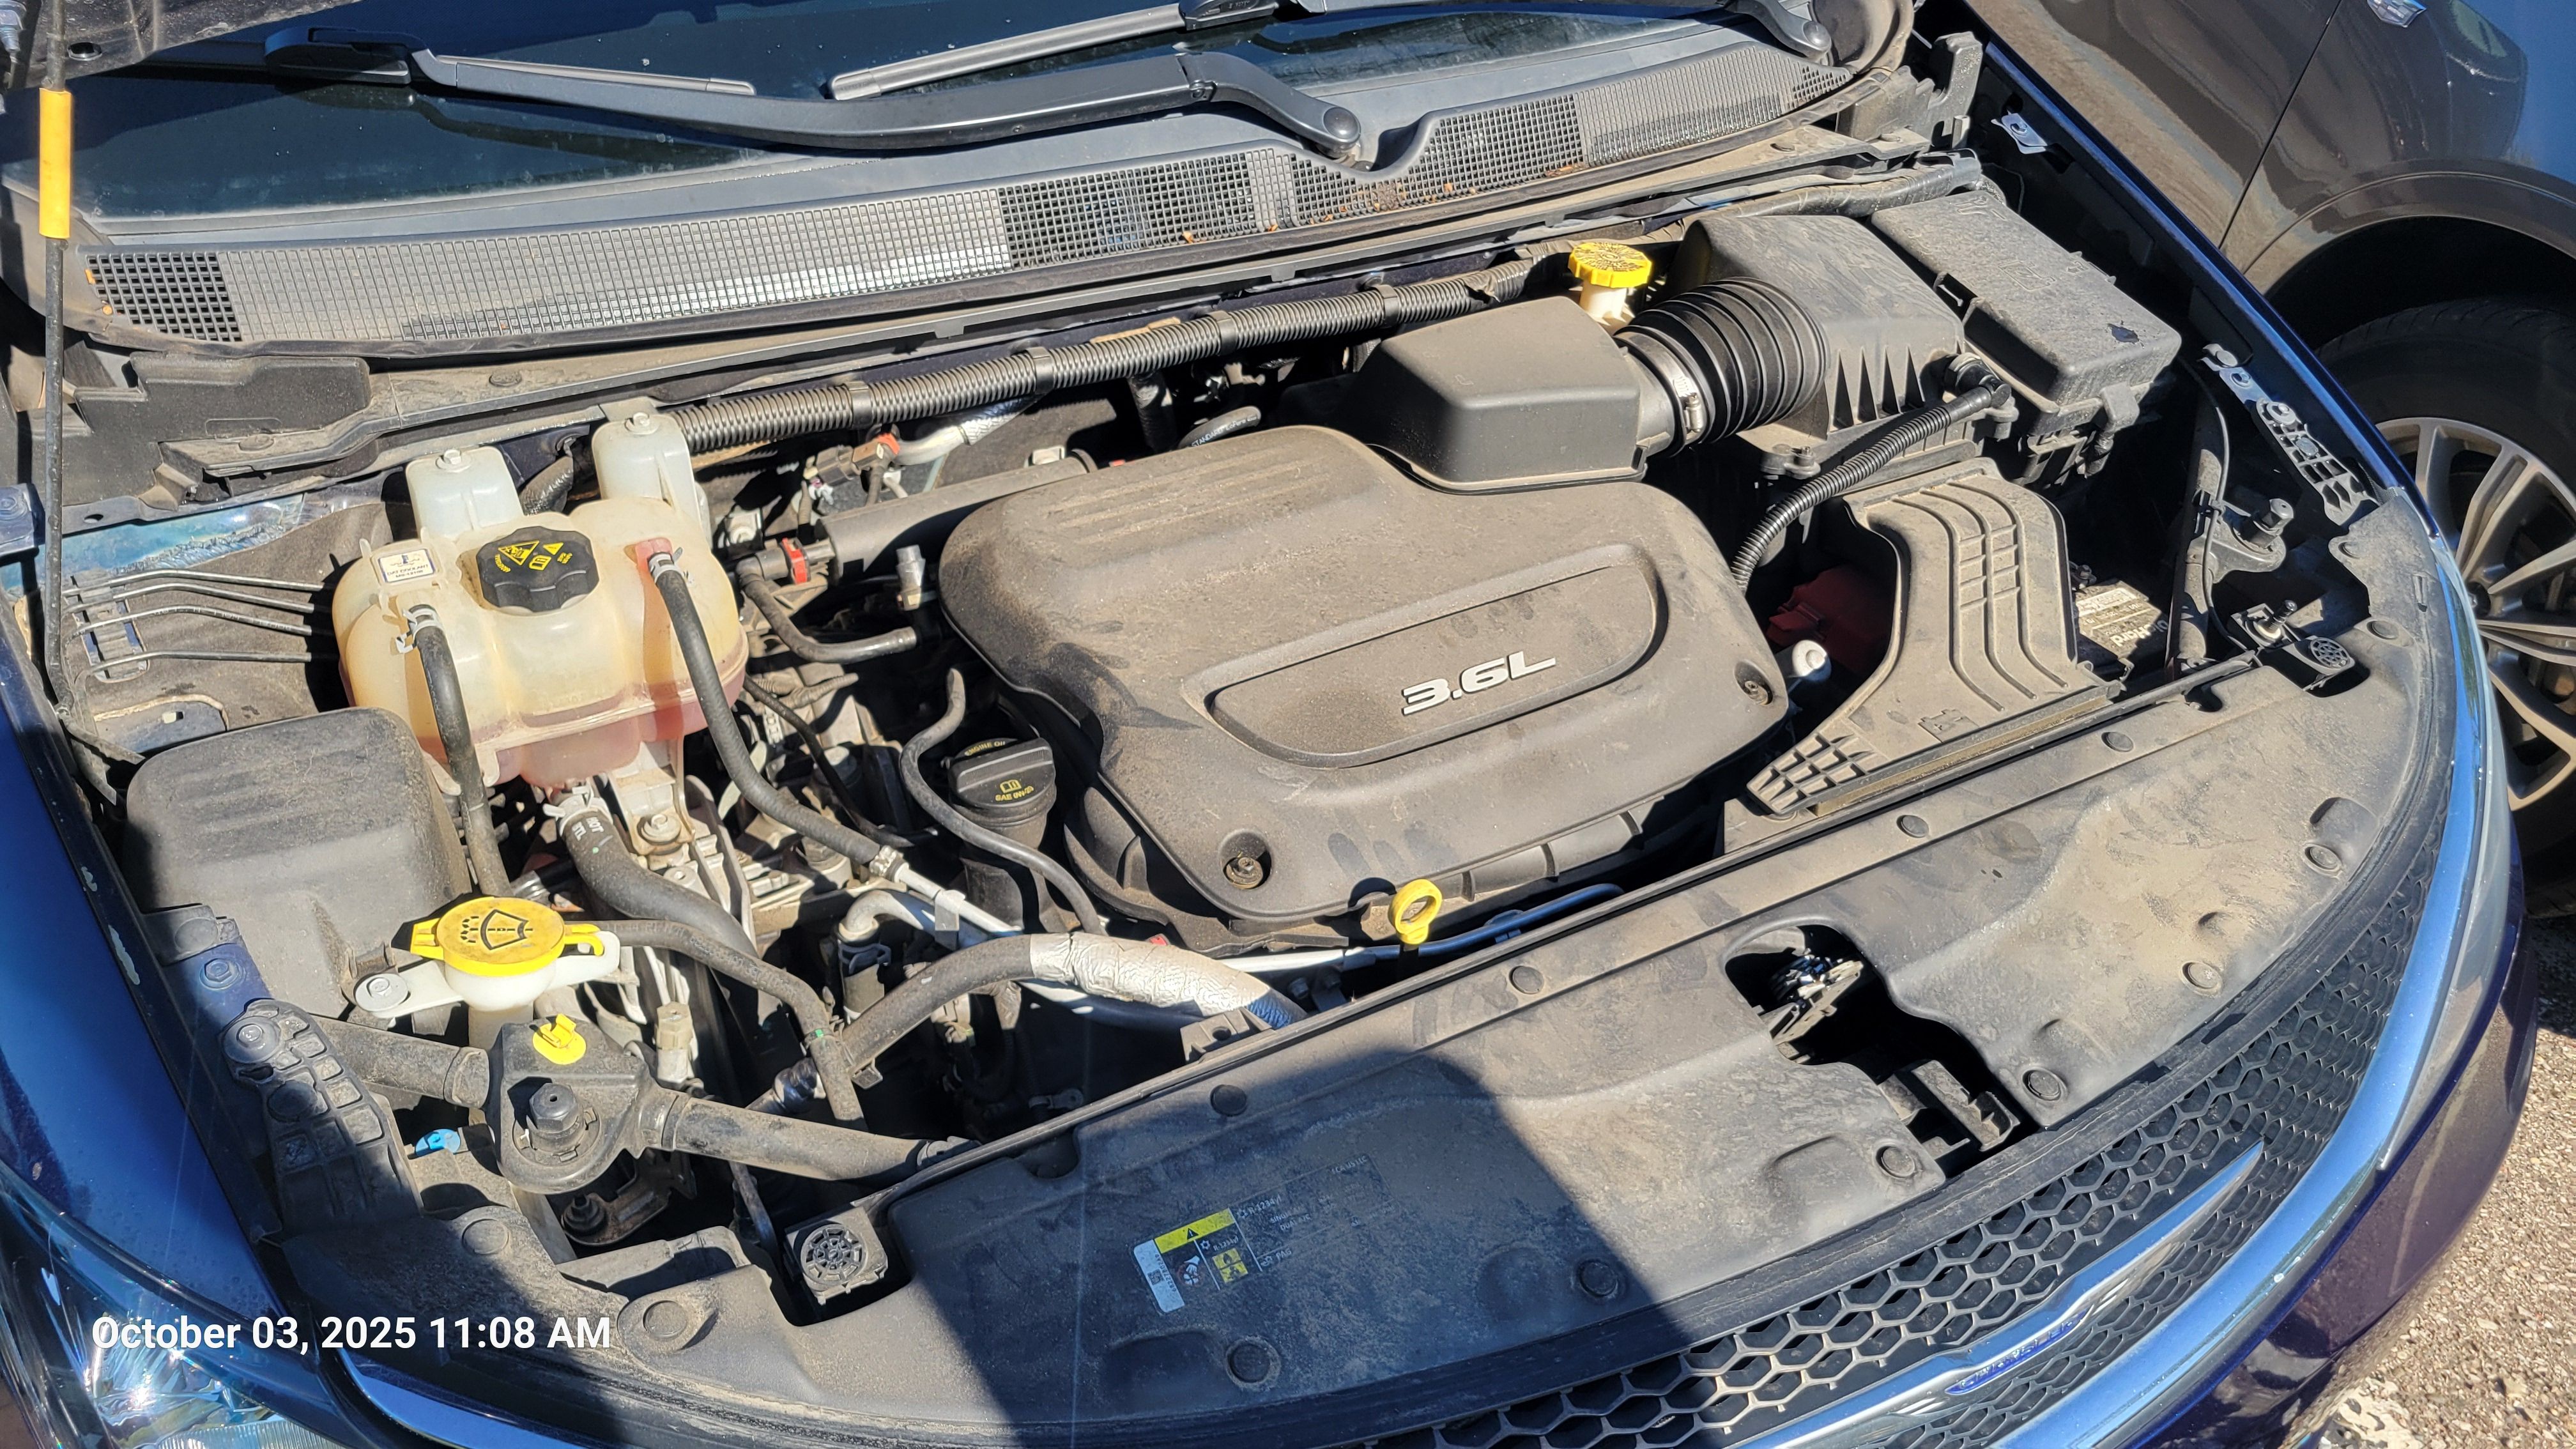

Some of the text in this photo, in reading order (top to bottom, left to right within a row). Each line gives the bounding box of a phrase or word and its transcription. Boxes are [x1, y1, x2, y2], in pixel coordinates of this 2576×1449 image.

[1401, 650, 1556, 716] 3.6L
[964, 742, 992, 756] ENGINE
[995, 793, 1013, 802] SAE
